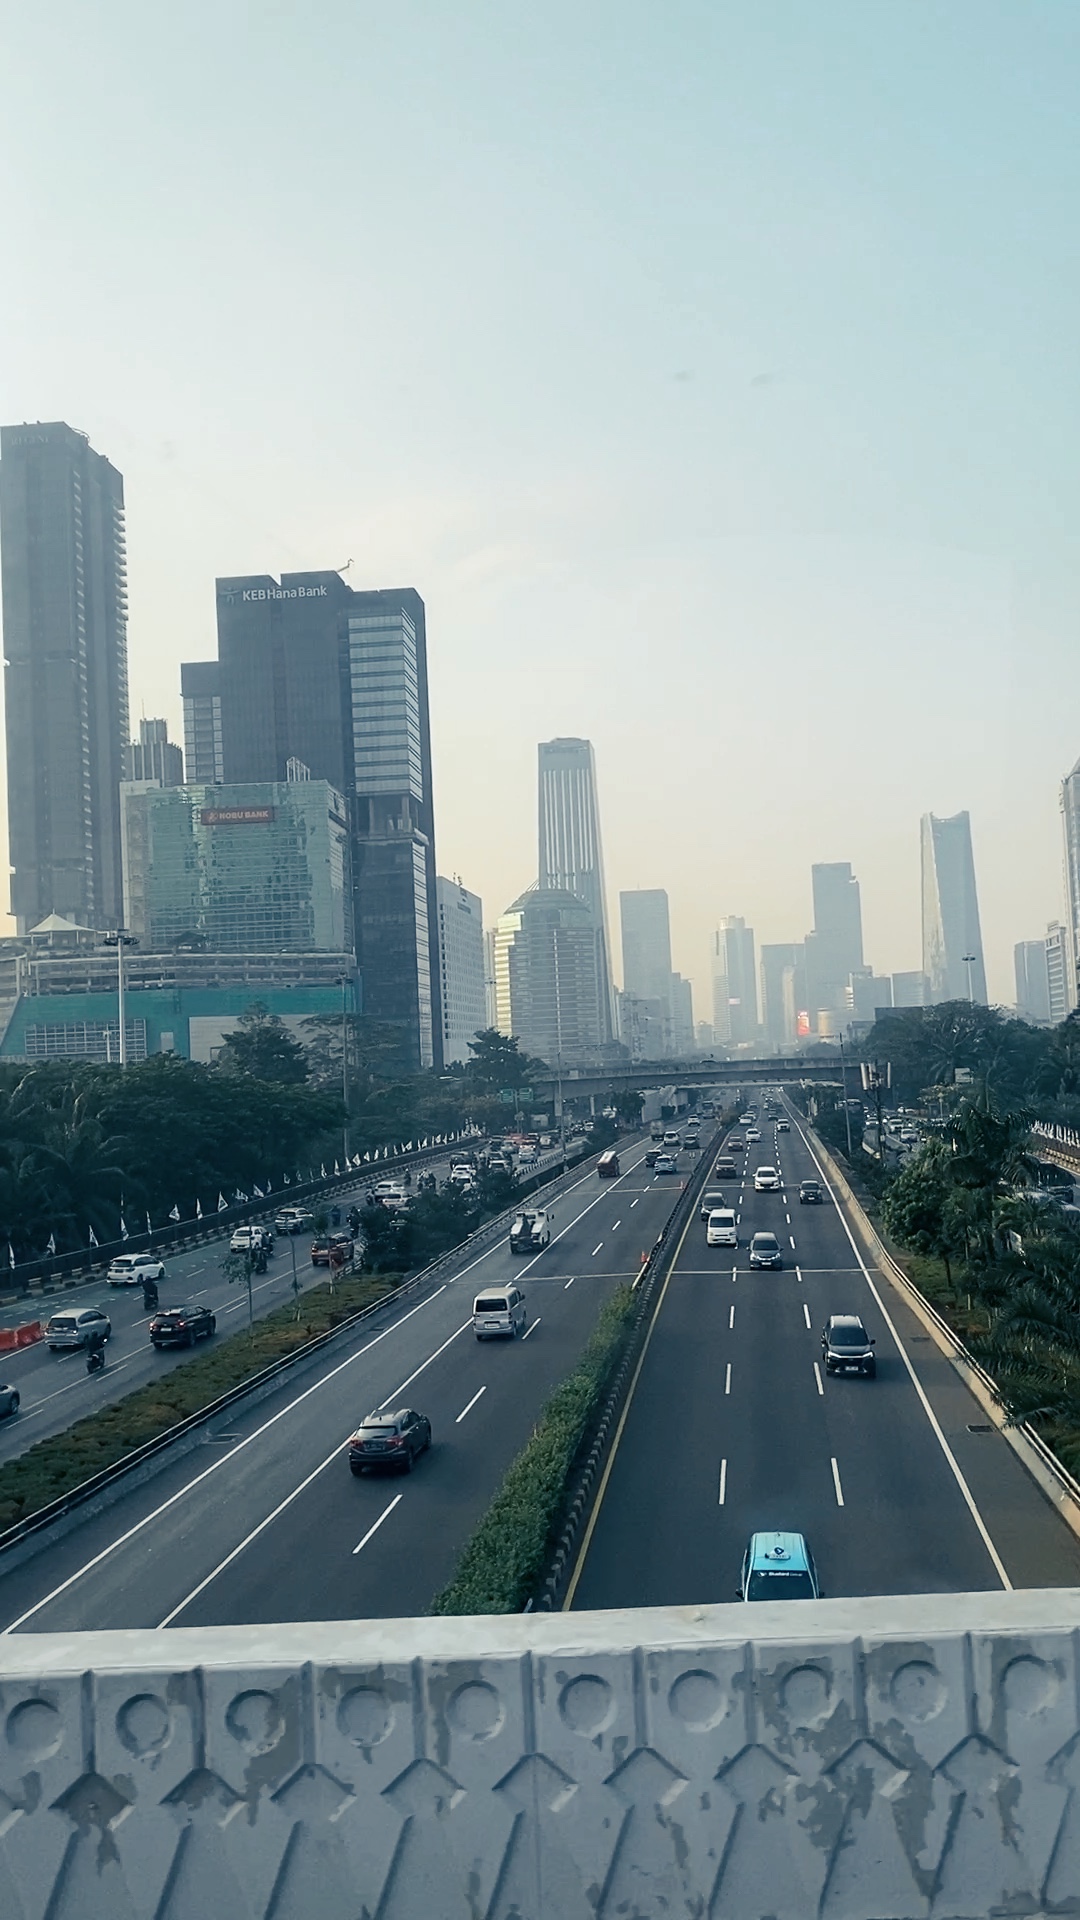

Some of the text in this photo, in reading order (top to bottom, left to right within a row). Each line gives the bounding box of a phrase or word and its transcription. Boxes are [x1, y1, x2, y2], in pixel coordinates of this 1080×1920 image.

[242, 585, 328, 601] KEB Hana Bank
[244, 810, 269, 819] BANK
